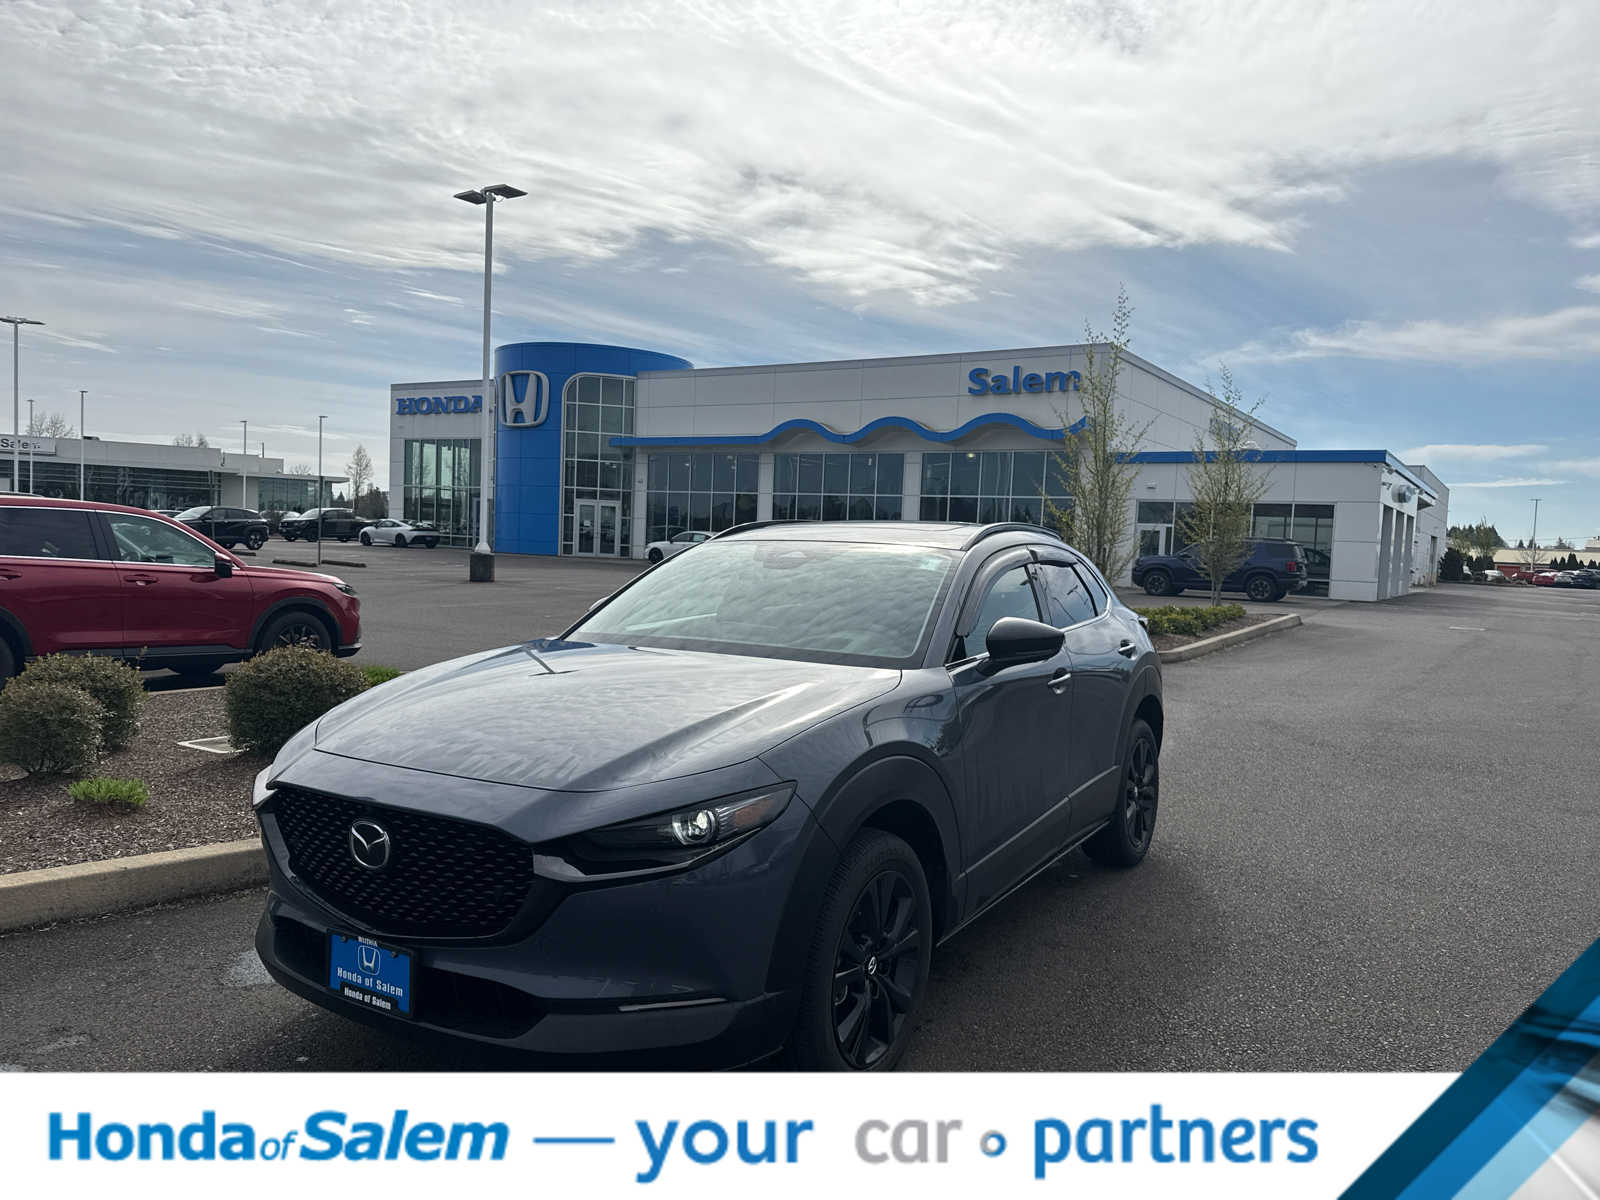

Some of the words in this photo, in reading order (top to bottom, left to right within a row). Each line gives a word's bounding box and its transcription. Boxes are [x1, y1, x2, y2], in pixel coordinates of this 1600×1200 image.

[968, 365, 1081, 395] Salem
[395, 395, 483, 415] HONDA
[337, 966, 362, 985] Honda
[364, 977, 373, 988] of
[376, 979, 404, 997] Salem
[344, 986, 363, 1001] Honda
[364, 994, 371, 1004] of
[372, 996, 391, 1010] Salem
